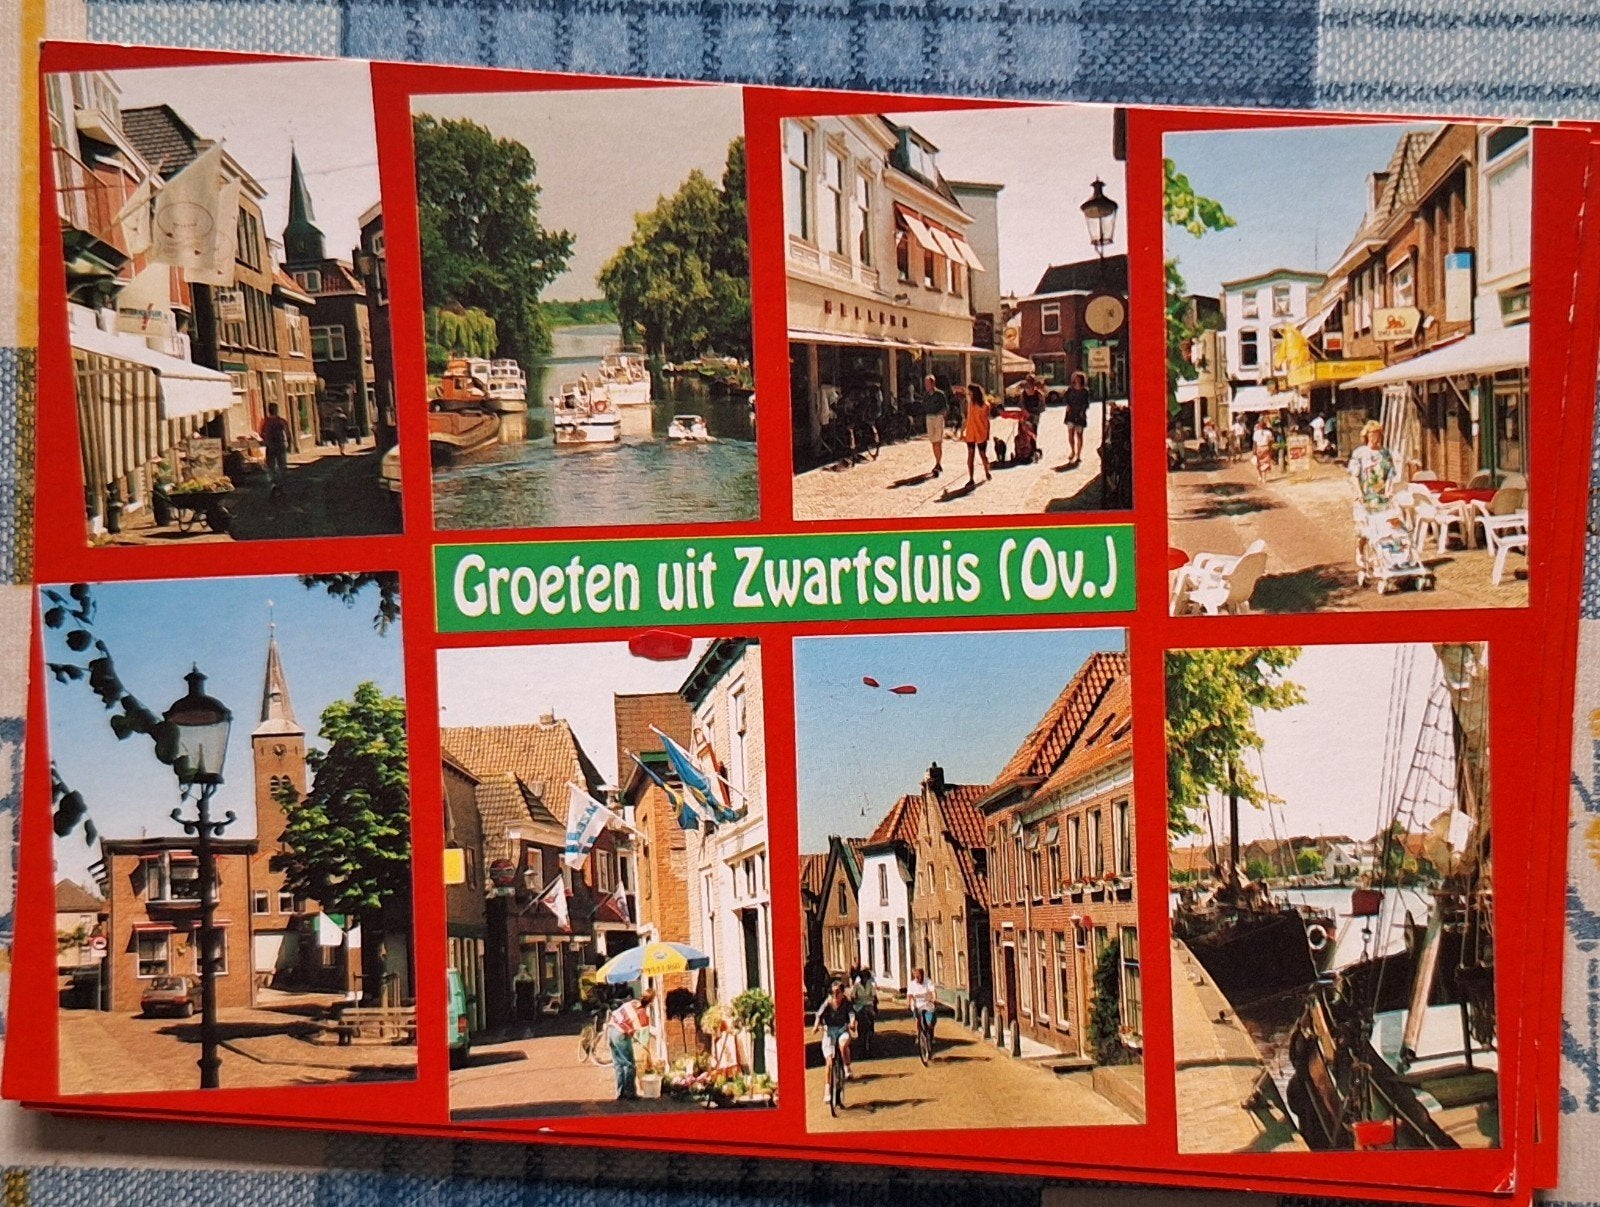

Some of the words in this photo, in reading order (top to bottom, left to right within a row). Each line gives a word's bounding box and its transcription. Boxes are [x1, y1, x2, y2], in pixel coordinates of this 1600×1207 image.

[453, 553, 640, 617] Groeten
[657, 546, 717, 612] uit
[733, 539, 981, 609] Zwartsluis
[999, 535, 1118, 602] (Ov.)
